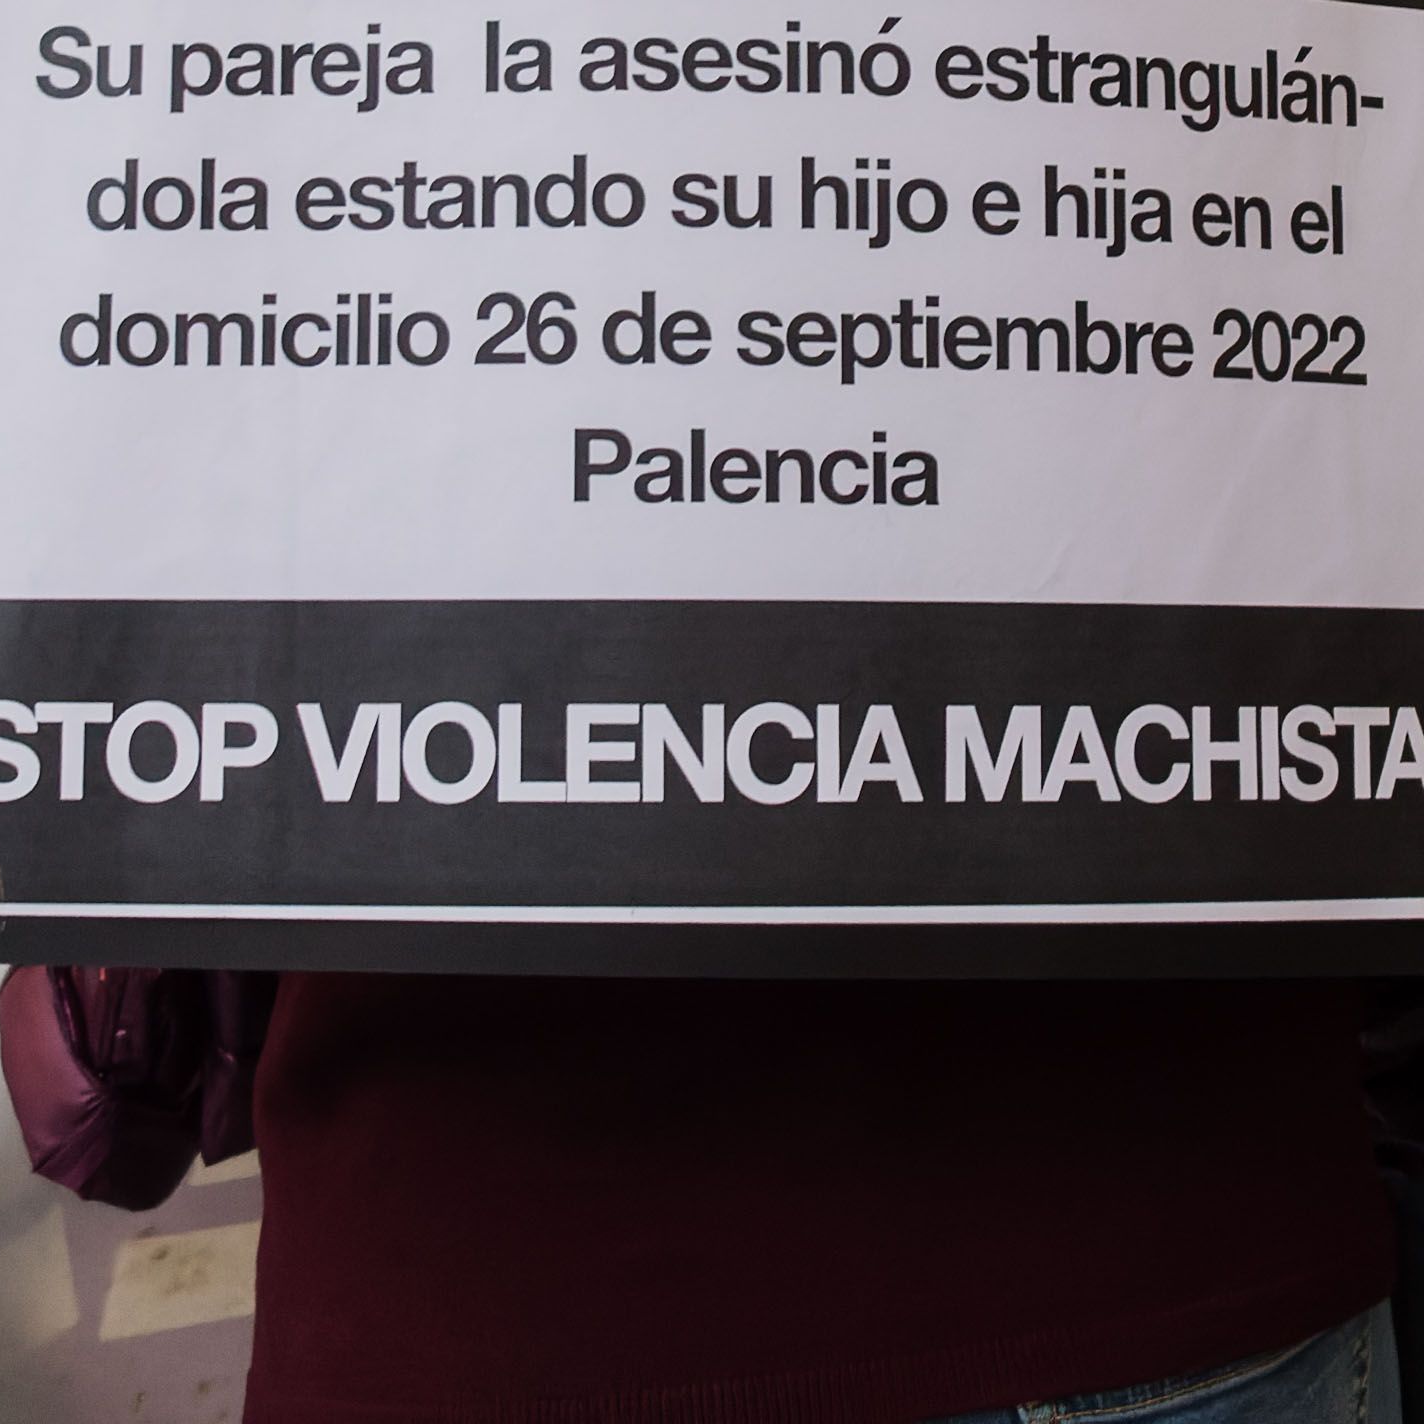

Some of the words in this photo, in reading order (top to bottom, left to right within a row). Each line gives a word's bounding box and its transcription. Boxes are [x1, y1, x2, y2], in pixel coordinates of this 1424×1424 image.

[34, 24, 145, 101] Su
[169, 22, 435, 112] pareja
[484, 19, 554, 94] la
[578, 15, 912, 98] asesinó
[934, 33, 1385, 134] estrangulán-
[85, 156, 270, 233] dola
[294, 153, 647, 232] estando
[670, 172, 774, 230] su
[800, 155, 949, 250] hijo
[970, 180, 1022, 237] e
[1043, 163, 1174, 258] hija
[1191, 191, 1273, 251] en
[1289, 183, 1345, 256] el
[58, 291, 451, 369] domicilio
[473, 290, 579, 367] 26
[600, 289, 713, 367] de
[735, 294, 1196, 386] septiembre
[1211, 307, 1369, 387] 2022
[572, 427, 941, 508] Palencia
[294, 700, 922, 806] VIOLENCIA
